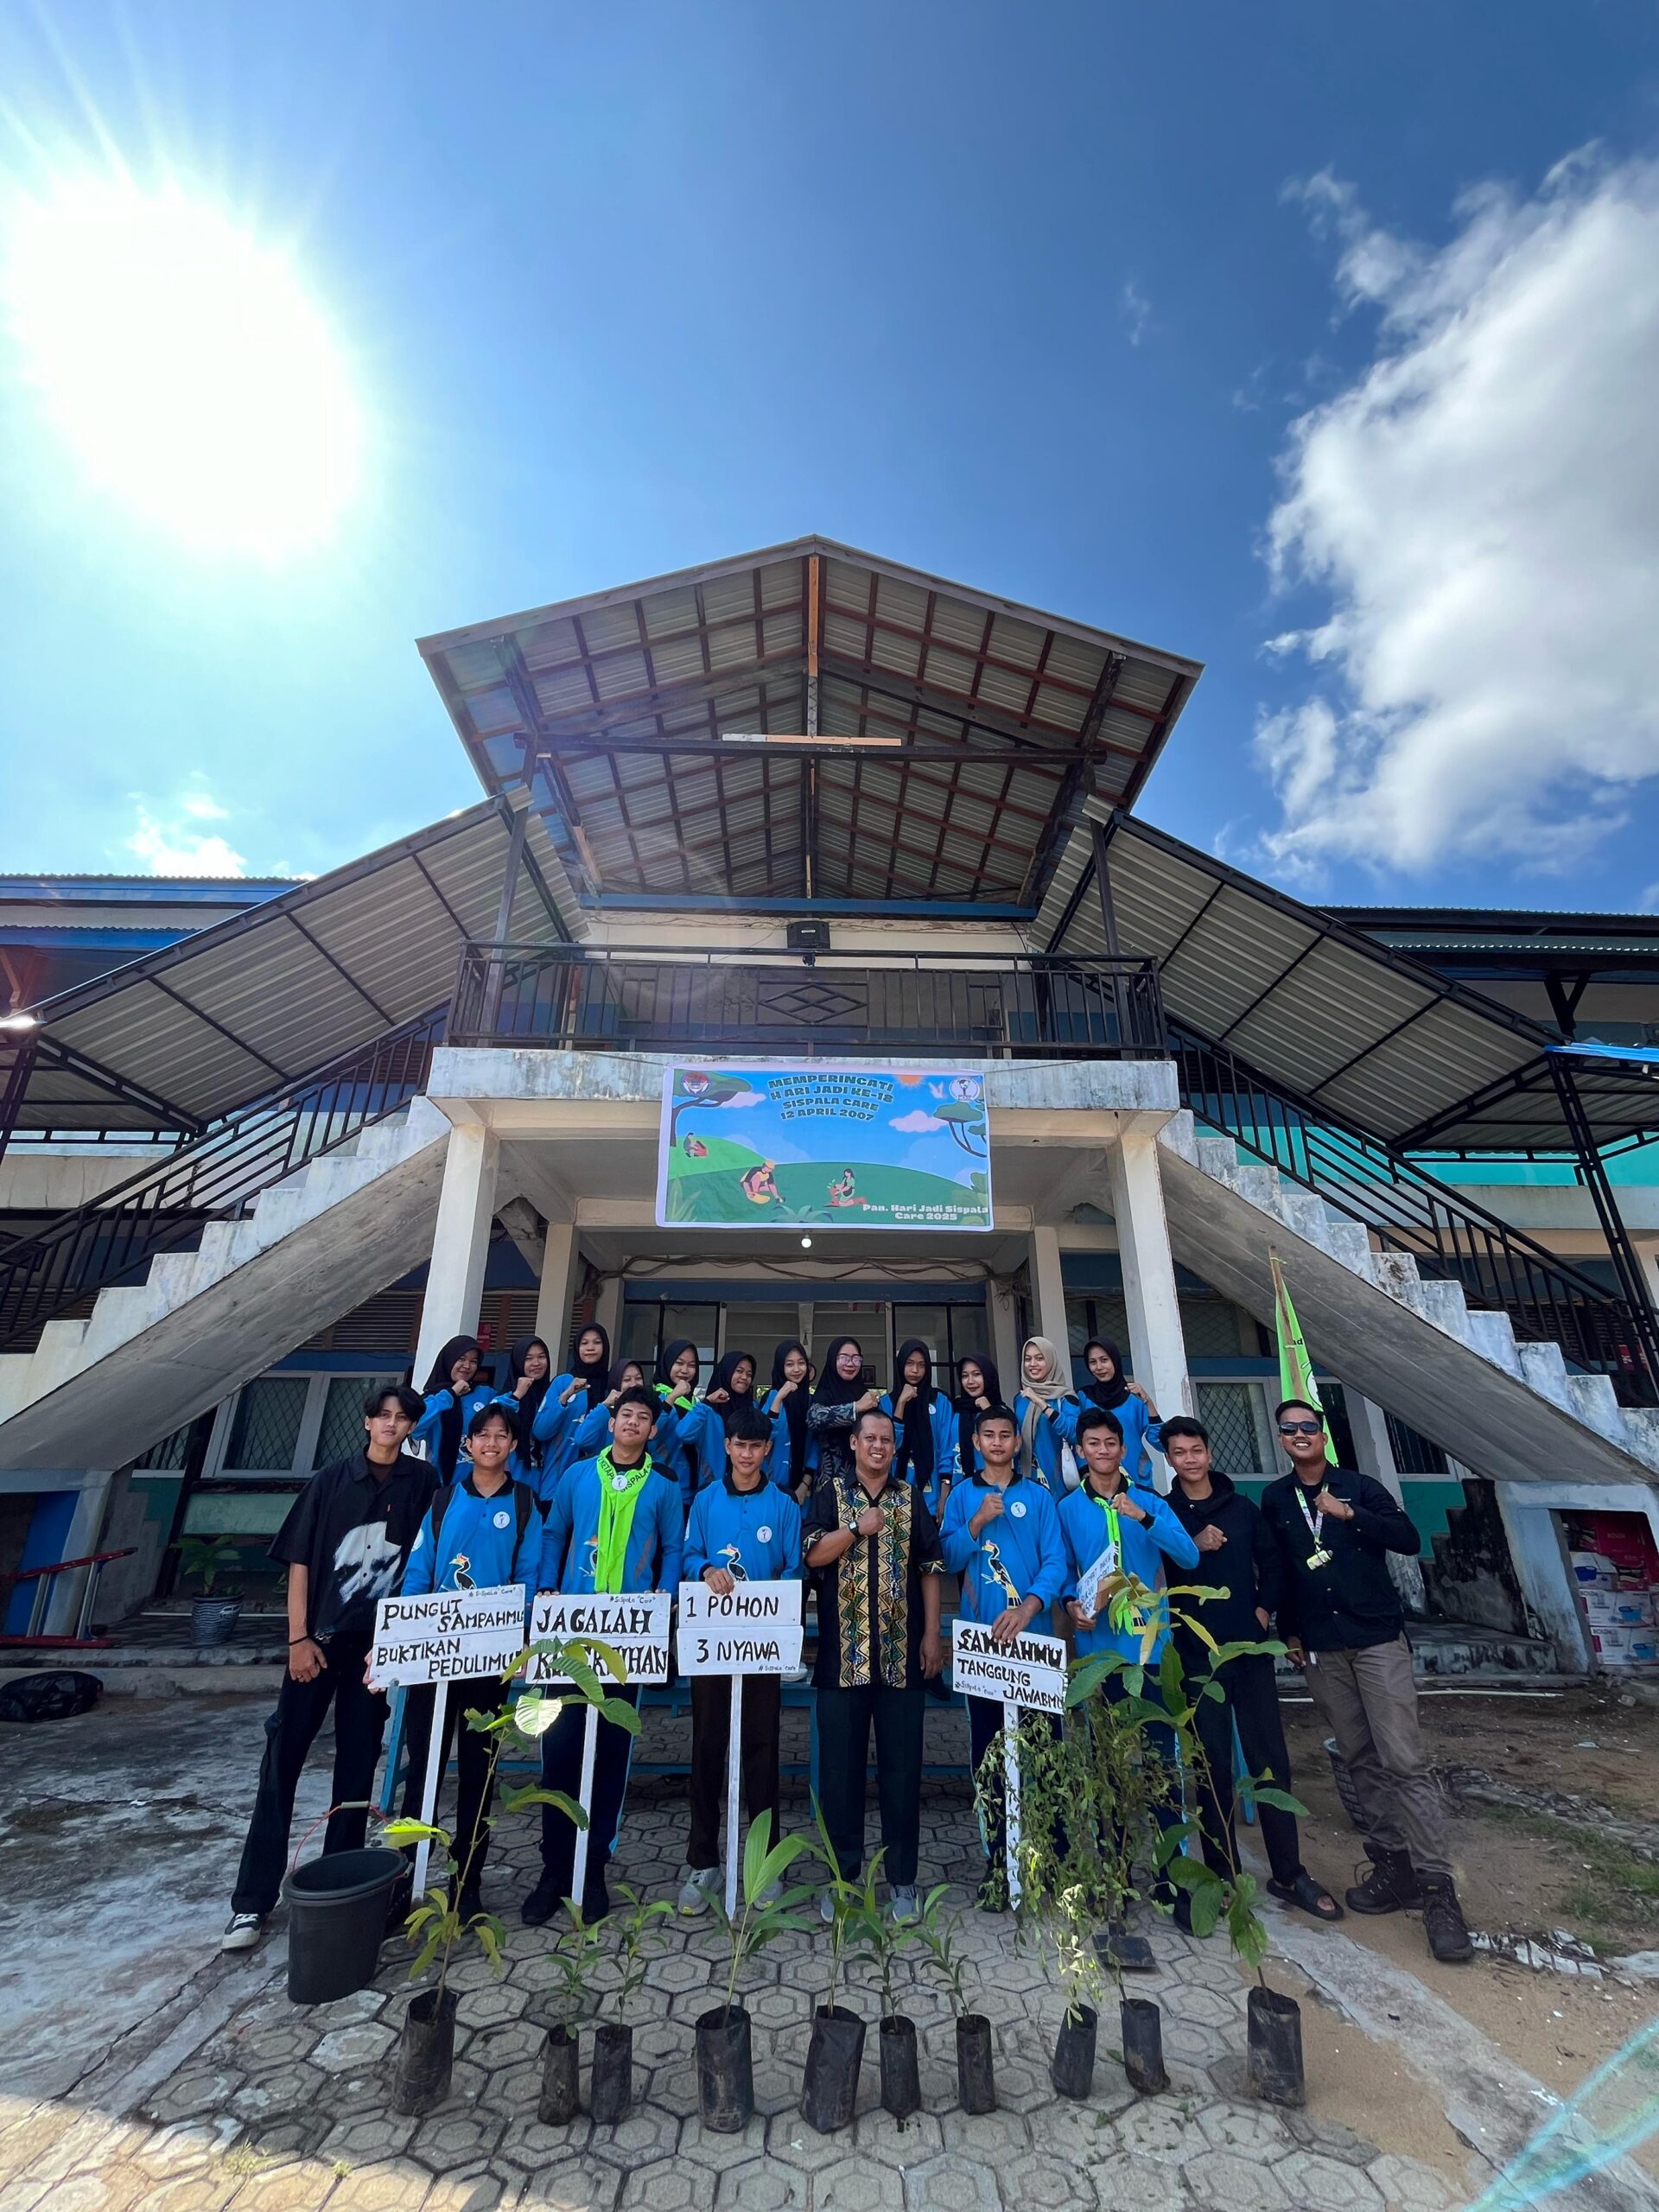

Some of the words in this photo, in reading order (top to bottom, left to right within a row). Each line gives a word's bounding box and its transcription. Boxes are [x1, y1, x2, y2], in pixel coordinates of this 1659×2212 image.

[783, 1097, 840, 1109] SISPALA
[842, 1098, 879, 1111] CARE
[851, 1087, 893, 1103] KE-18
[780, 1110, 794, 1120] 12
[840, 1109, 874, 1121] 2007
[945, 1205, 988, 1214] Sispala
[380, 1599, 463, 1631] PUNGUT
[686, 1596, 697, 1618] 1
[708, 1594, 779, 1618] POHON
[437, 1610, 524, 1633] SAMPAHMU
[537, 1605, 653, 1635] JAGALAH
[376, 1637, 461, 1668] BUKTIKAN
[696, 1639, 709, 1663] 3
[716, 1639, 780, 1662] NYAWA
[957, 1658, 1031, 1687] TANGGUNG
[1002, 1684, 1064, 1709] JAWABMU
